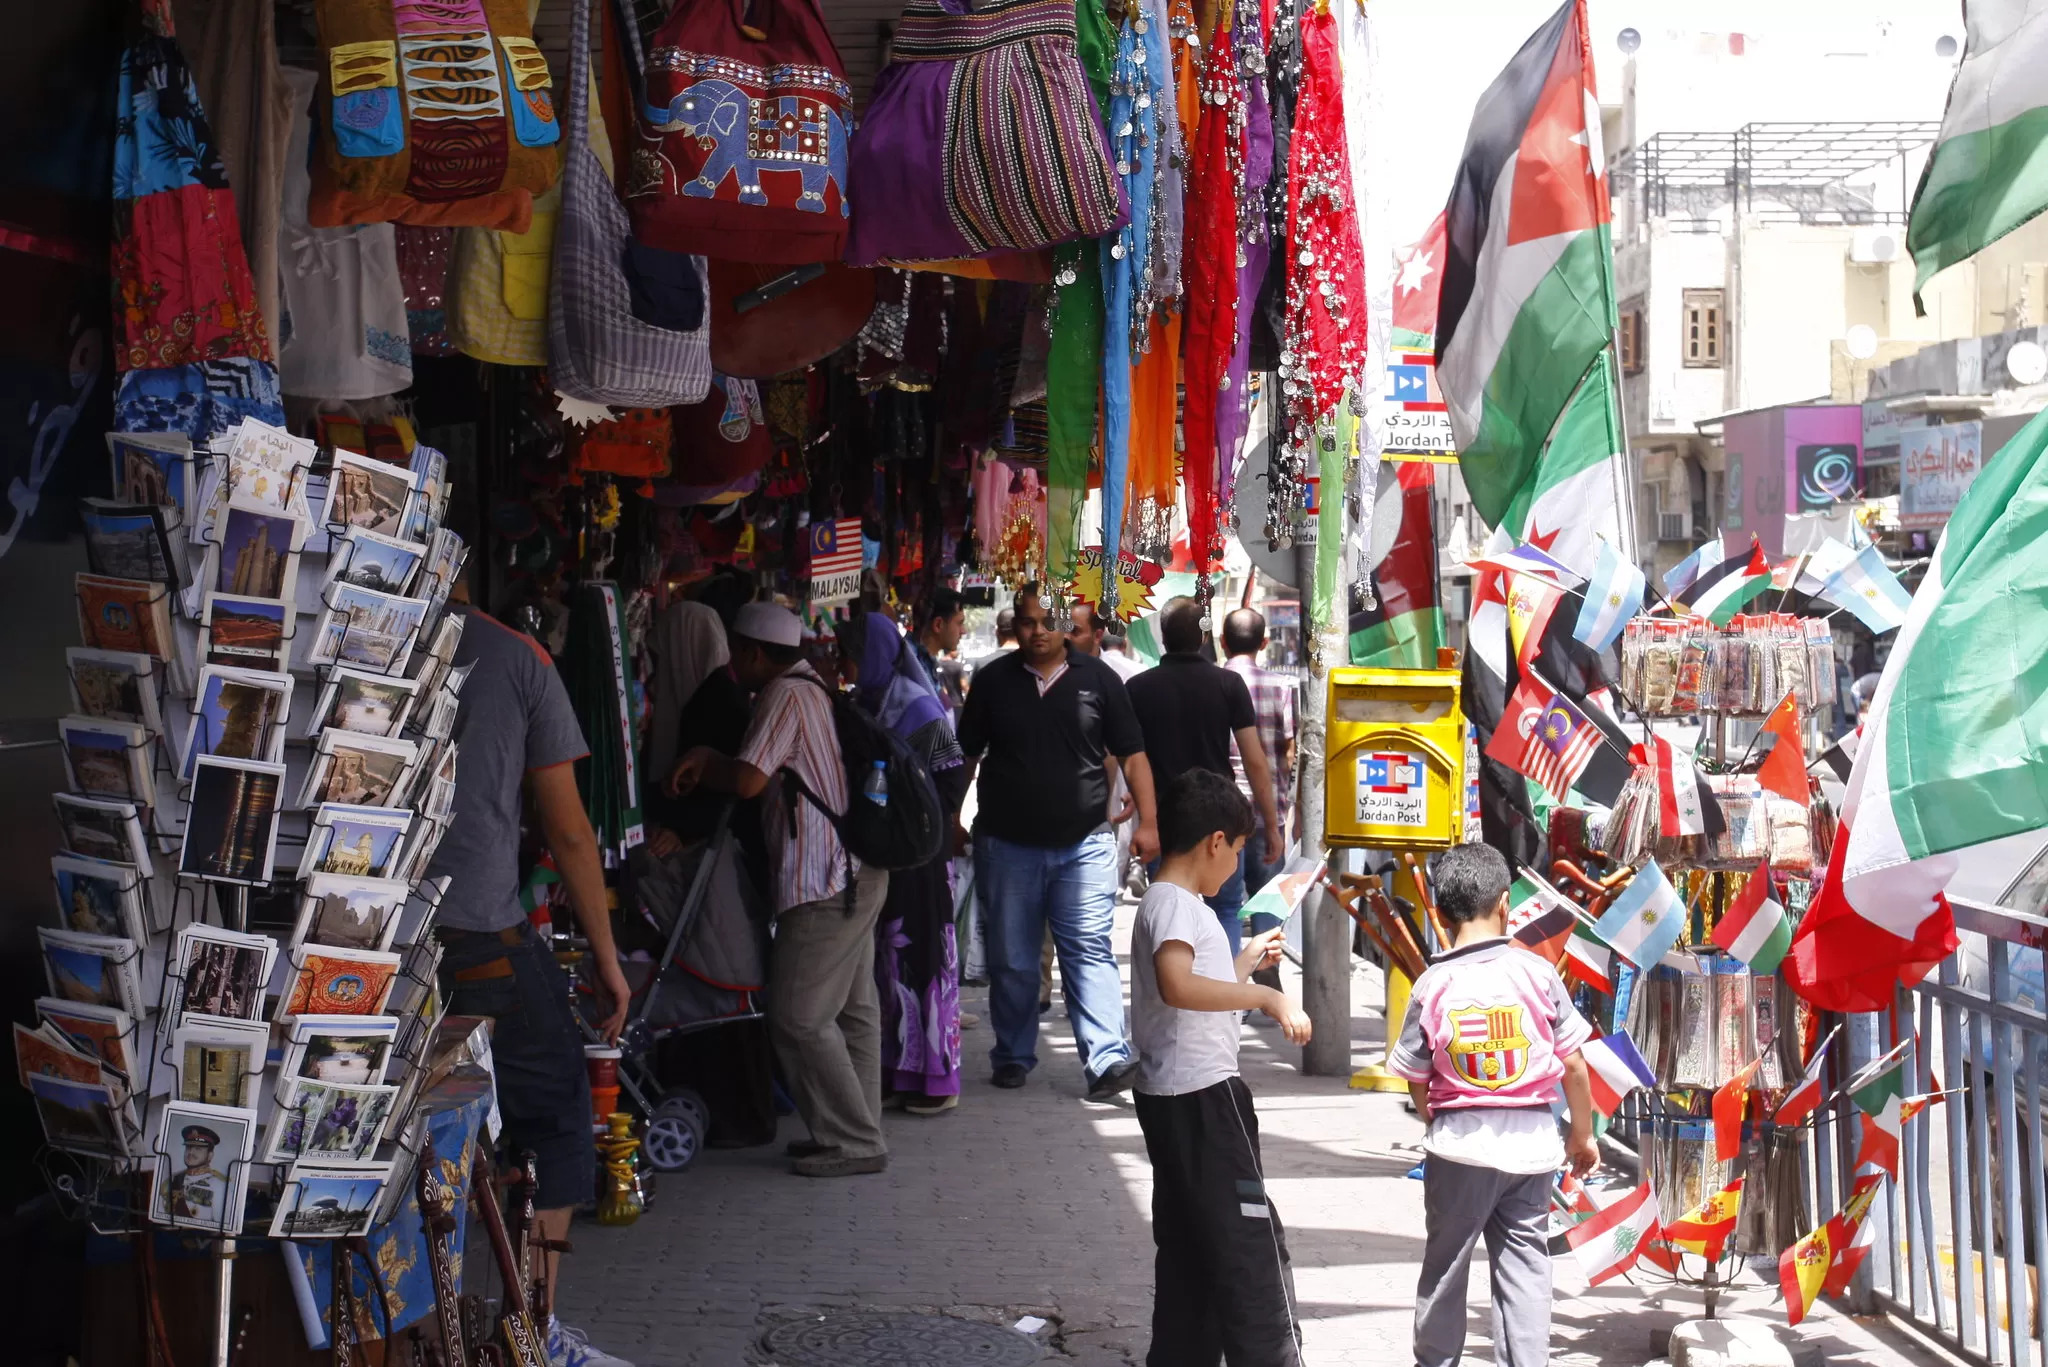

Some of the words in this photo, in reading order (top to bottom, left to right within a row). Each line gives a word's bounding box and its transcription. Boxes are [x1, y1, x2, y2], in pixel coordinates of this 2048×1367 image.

[1385, 431, 1441, 447] Jordan
[1083, 549, 1142, 580] Spial
[811, 575, 860, 600] MALAYSIA
[610, 625, 625, 697] SYRIA
[1395, 798, 1421, 811] البريد
[1358, 809, 1395, 821] Jordan
[1397, 811, 1421, 823] Post
[1471, 1041, 1505, 1051] FCB
